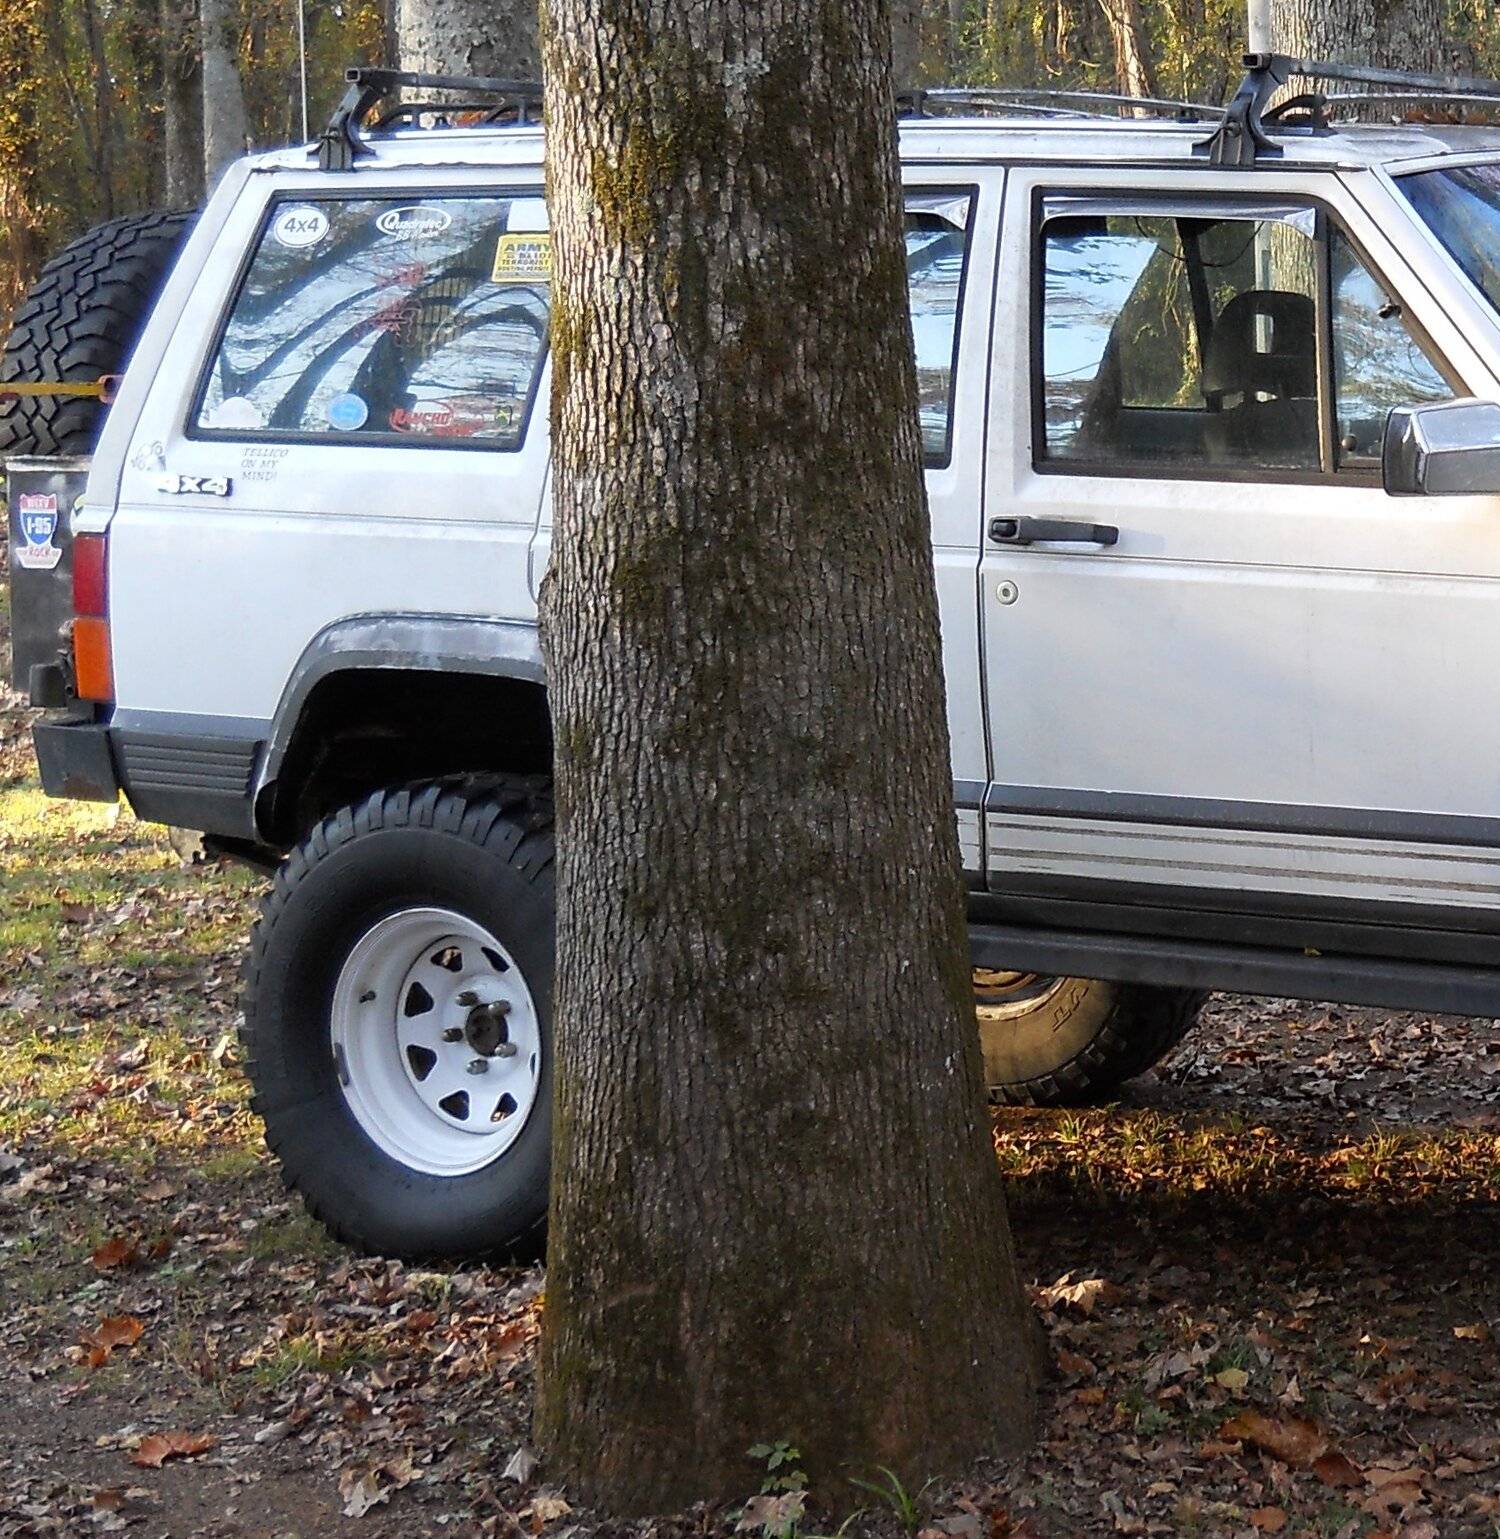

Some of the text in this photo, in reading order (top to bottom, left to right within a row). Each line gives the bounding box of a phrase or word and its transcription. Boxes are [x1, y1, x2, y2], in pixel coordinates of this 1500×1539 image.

[284, 217, 320, 233] 4x4
[243, 448, 289, 458] TELLICO
[241, 459, 279, 469] ON MY
